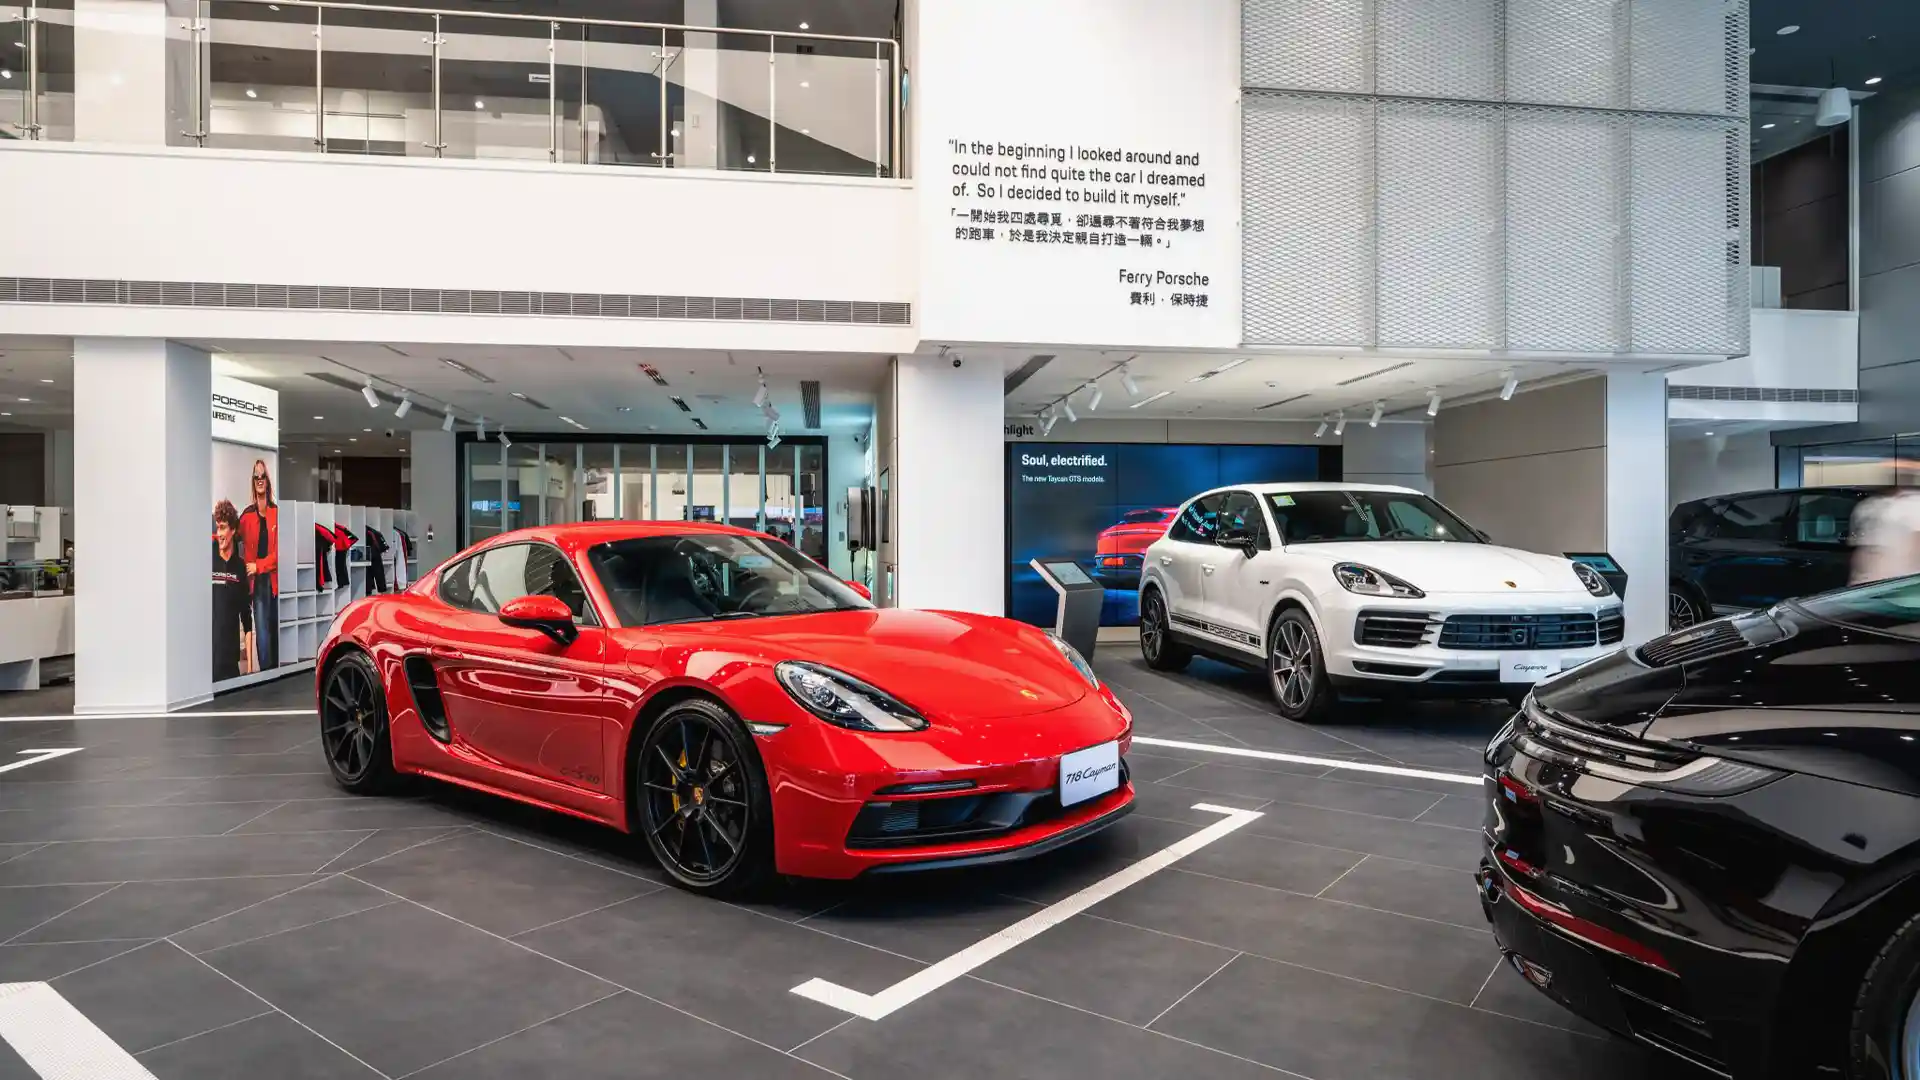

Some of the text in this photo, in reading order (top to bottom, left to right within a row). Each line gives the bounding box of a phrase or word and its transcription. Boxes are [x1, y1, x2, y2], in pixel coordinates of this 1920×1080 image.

[971, 140, 994, 155] the
[998, 142, 1065, 162] beginning
[1078, 145, 1121, 162] looked
[1125, 150, 1171, 165] around
[1175, 152, 1199, 166] and
[952, 162, 990, 177] could
[995, 165, 1018, 178] not
[1021, 164, 1046, 179] find
[1051, 166, 1085, 183] quite
[1089, 168, 1111, 182] the
[1115, 171, 1136, 183] car
[1147, 170, 1205, 187] dreamed
[952, 182, 969, 197] of.
[977, 183, 995, 198] So
[1007, 185, 1061, 202] decided
[1066, 187, 1079, 202] to
[1083, 188, 1116, 203] build
[1120, 190, 1129, 204] it
[1119, 268, 1209, 287] Ferry Porsche
[212, 393, 268, 415] PORSCHE
[212, 411, 236, 423] LIFESTYLE
[1021, 454, 1107, 467] Soul, electrified.
[1022, 474, 1034, 483] The
[1034, 475, 1047, 483] new
[1048, 474, 1068, 484] Taycan
[1069, 475, 1081, 483] GTS
[1209, 625, 1248, 642] PORSCHE
[1513, 663, 1548, 672] Cayenne
[1066, 763, 1116, 784] 718 Cayman
